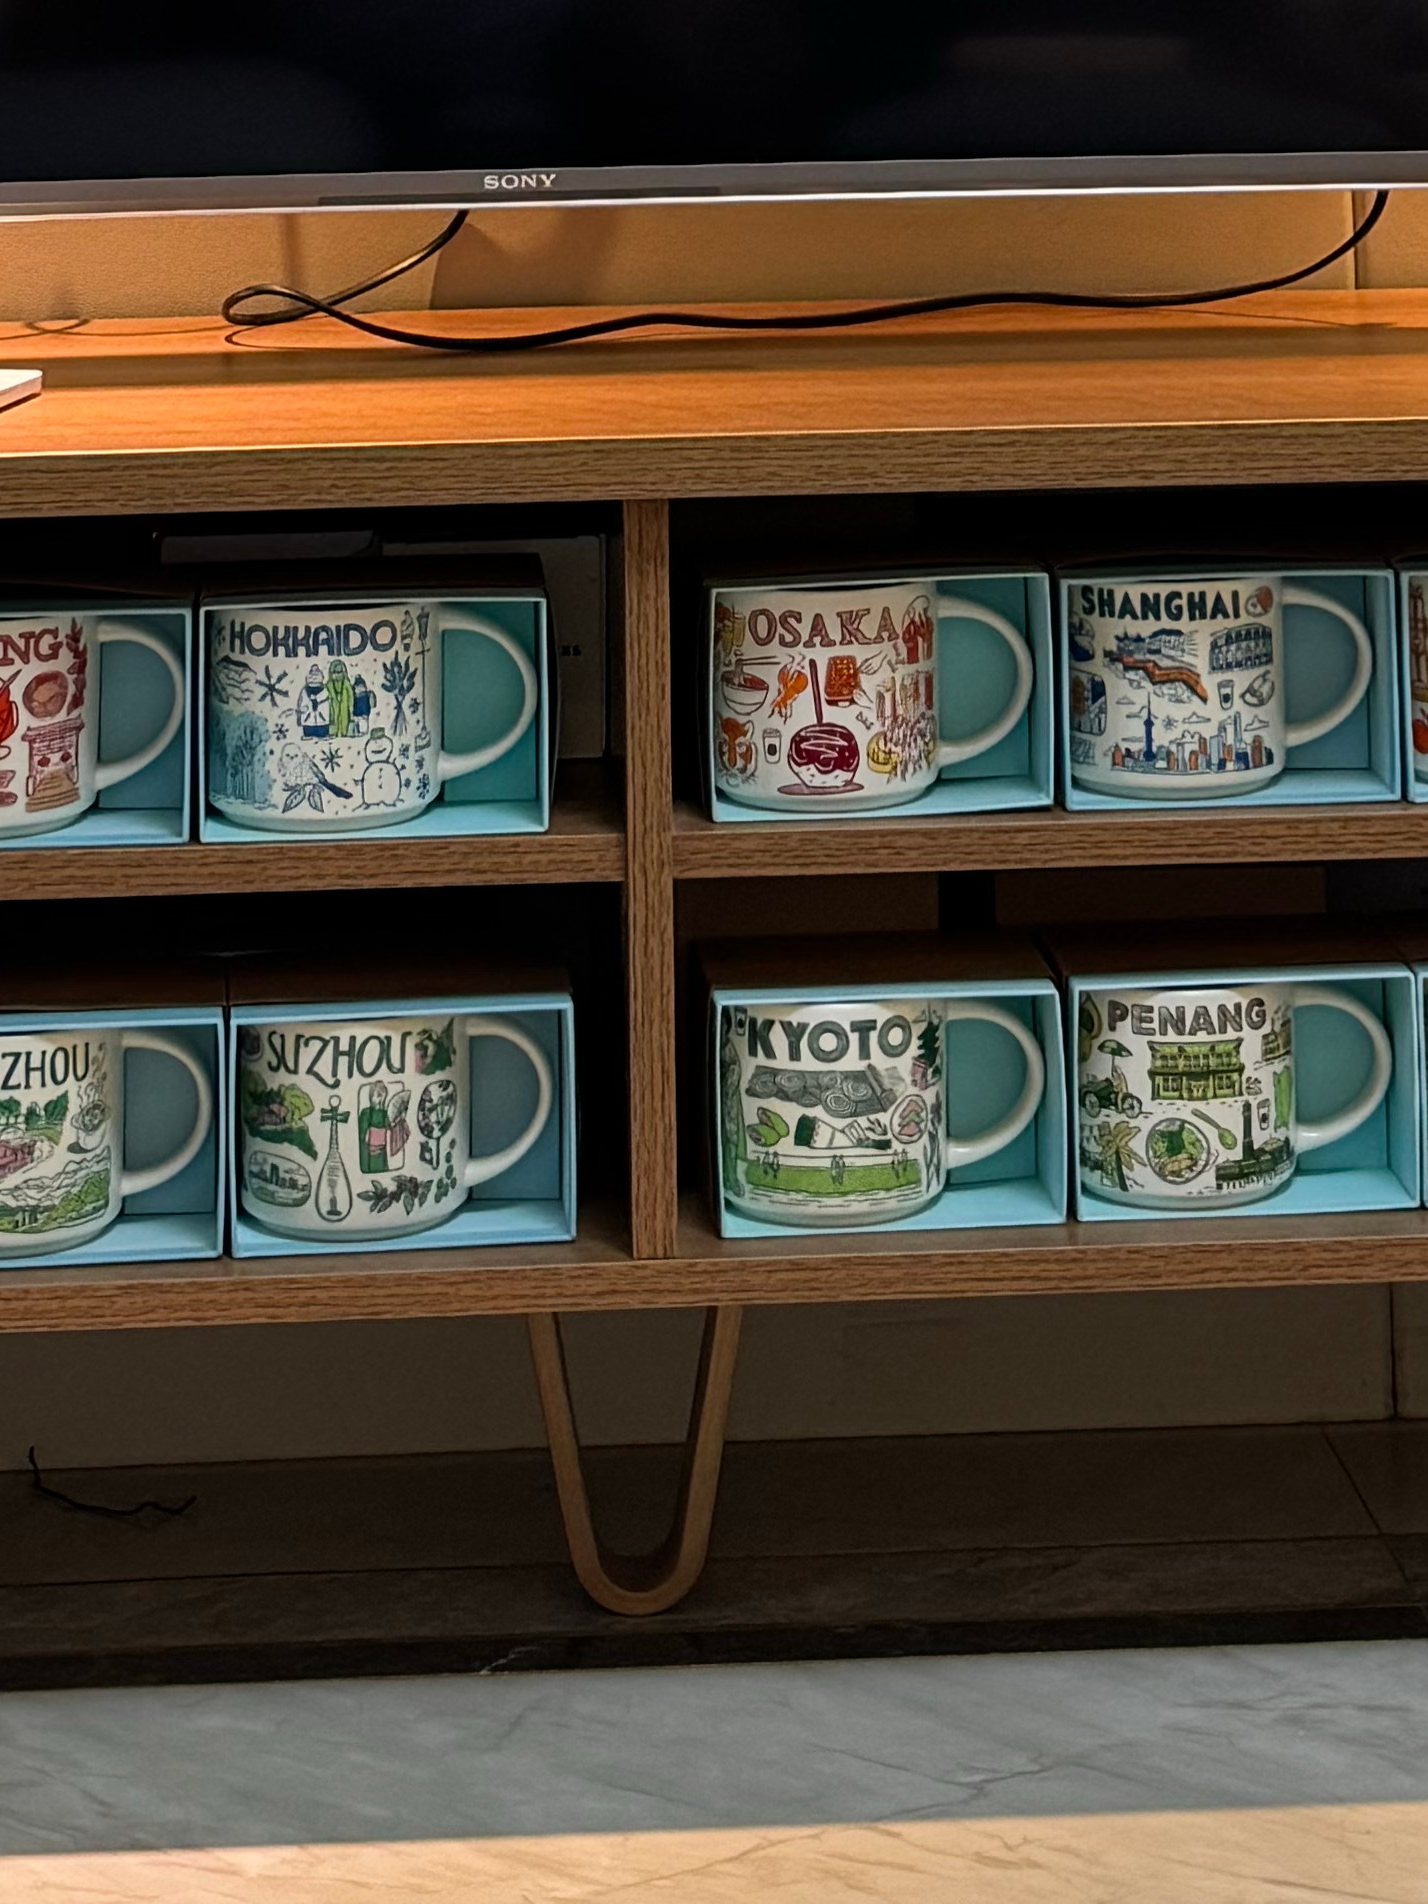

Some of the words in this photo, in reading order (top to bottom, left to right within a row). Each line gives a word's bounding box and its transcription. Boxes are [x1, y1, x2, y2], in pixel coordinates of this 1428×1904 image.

[484, 174, 557, 189] SONY
[1081, 584, 1241, 622] SHANGHAI
[229, 619, 398, 658] HOKKAIDO
[748, 606, 900, 649] OSAKA
[1107, 997, 1267, 1037] PENANG
[747, 1015, 913, 1063] KYOTO
[266, 1030, 413, 1089] SUZHOU
